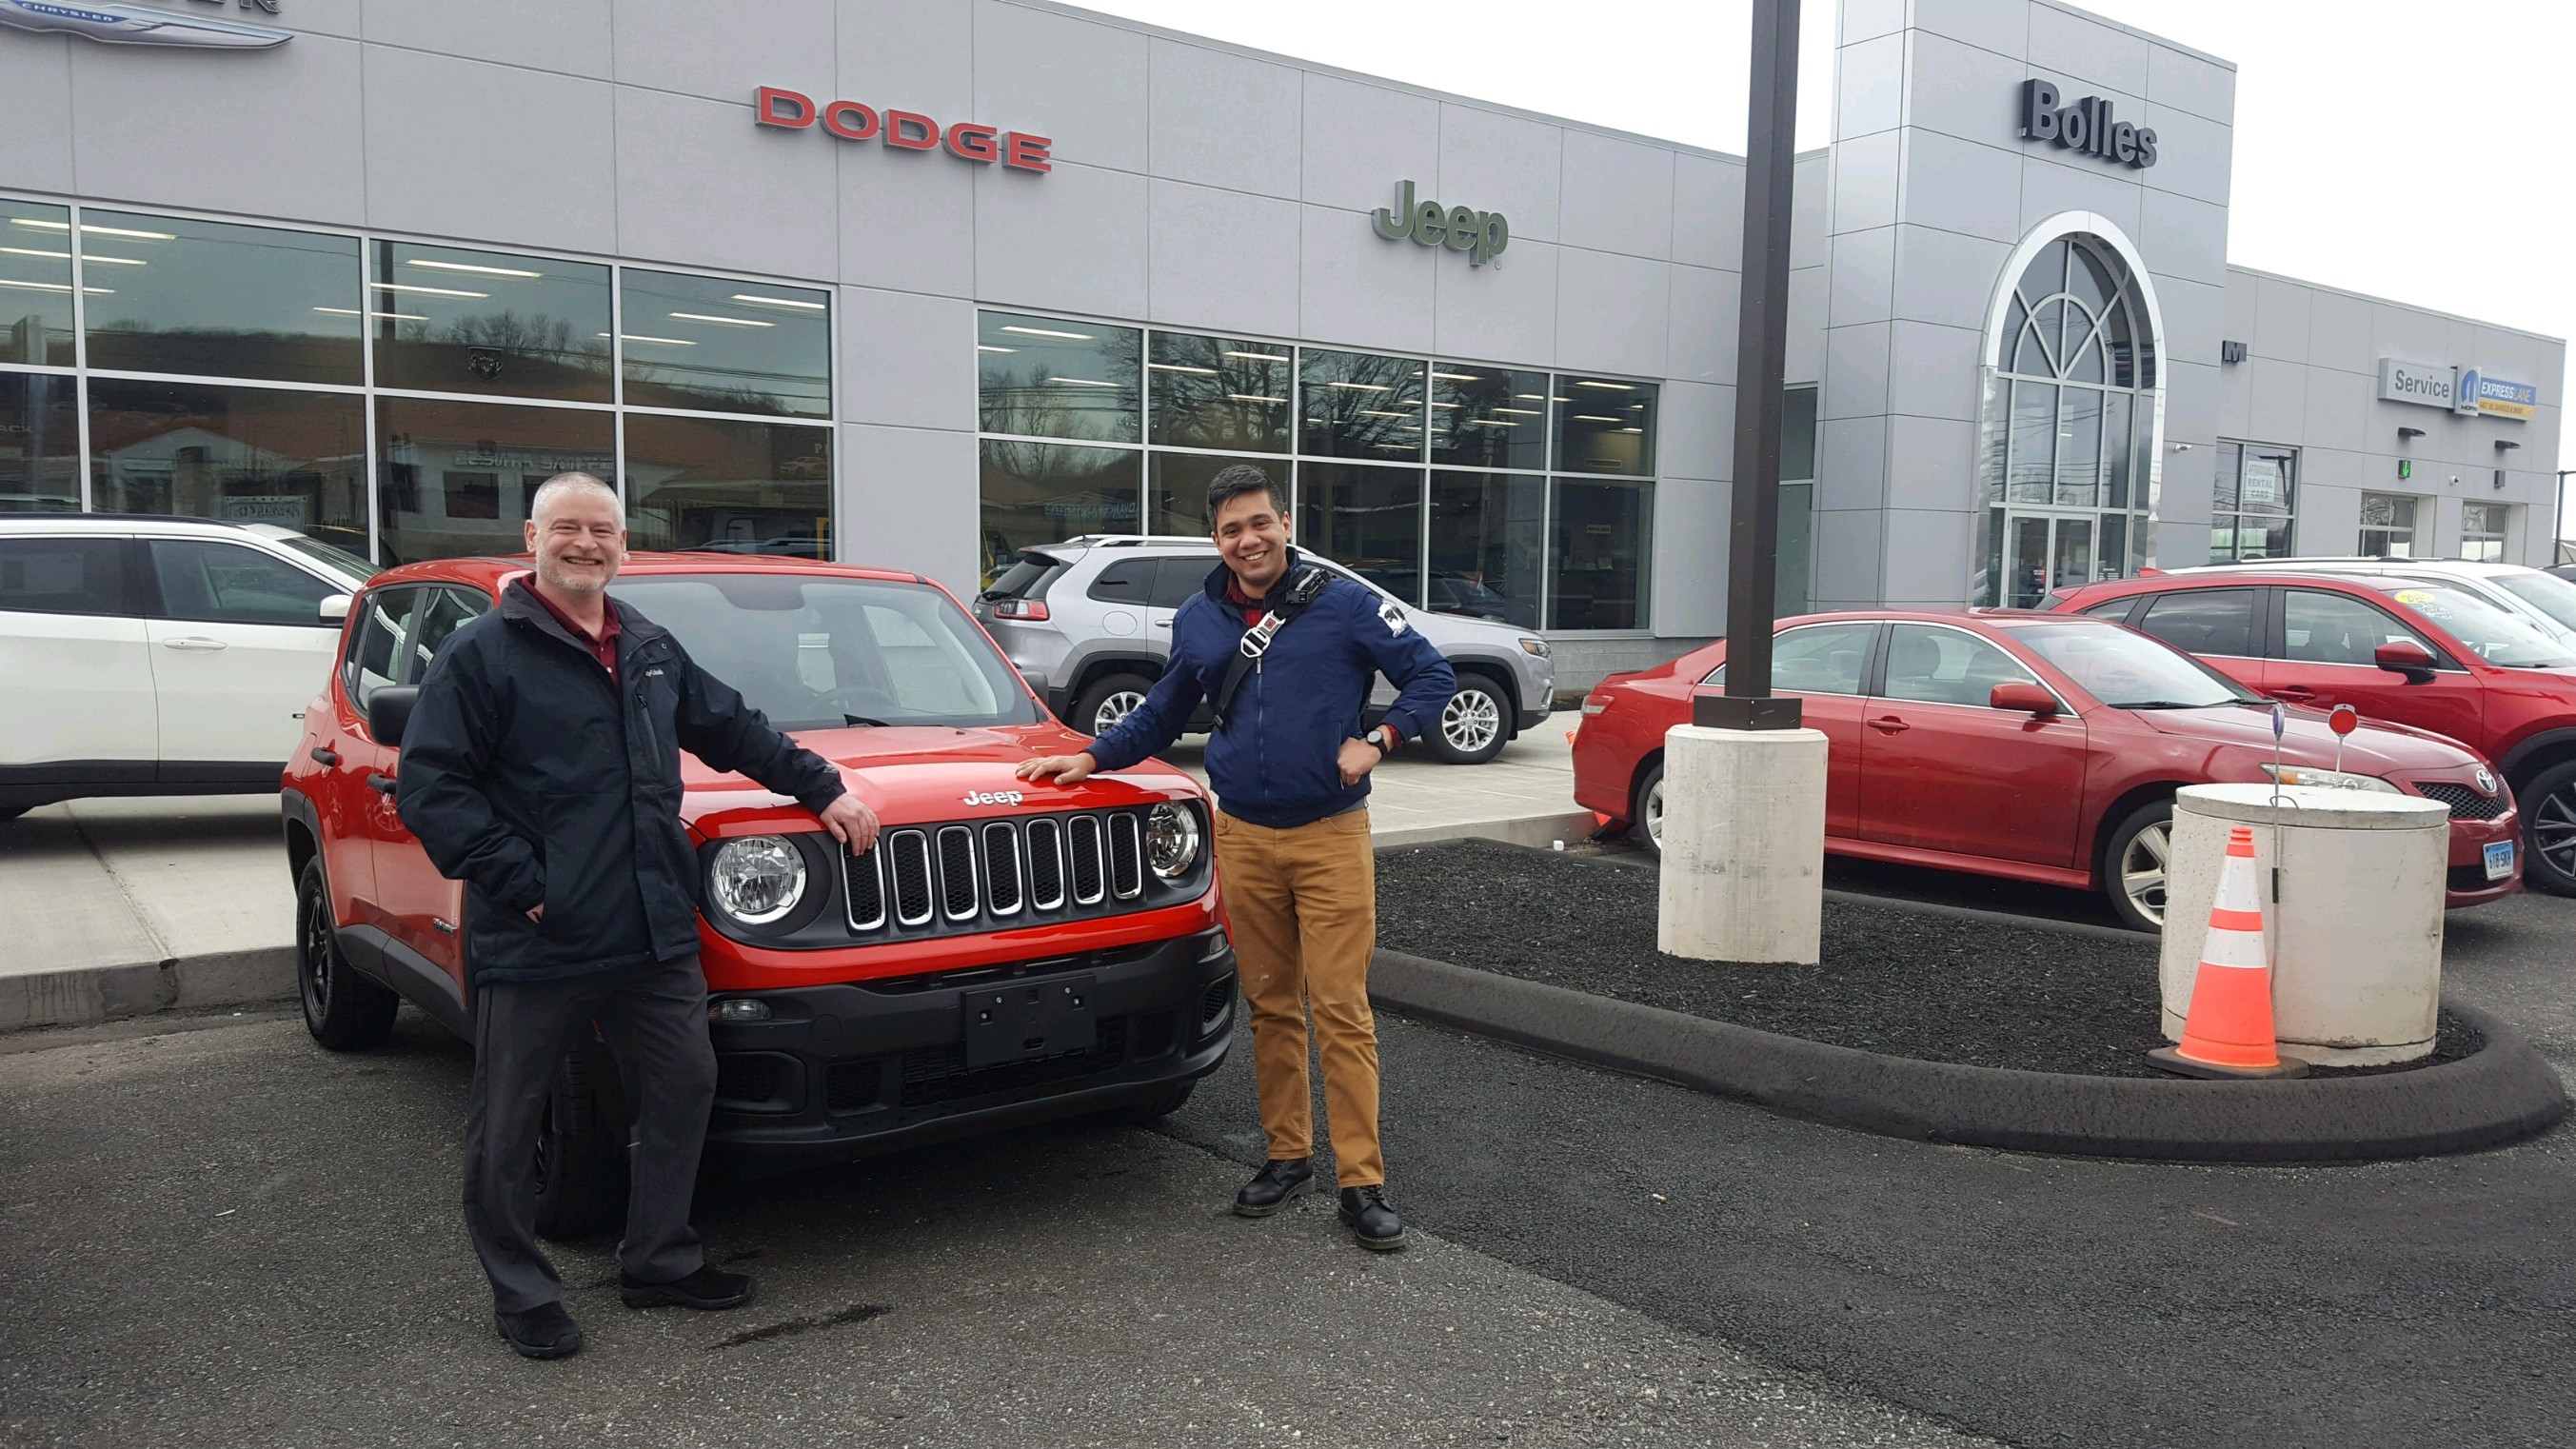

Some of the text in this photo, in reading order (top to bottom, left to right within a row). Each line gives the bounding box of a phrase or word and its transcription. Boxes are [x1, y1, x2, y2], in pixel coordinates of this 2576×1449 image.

[21, 2, 114, 22] CHRYSLER
[753, 85, 1053, 174] DODGE
[2022, 78, 2157, 169] Bolles
[1371, 179, 1509, 267] Jeep
[2394, 368, 2450, 398] Service
[2248, 478, 2273, 488] RENTAL
[962, 790, 1023, 807] Jeep
